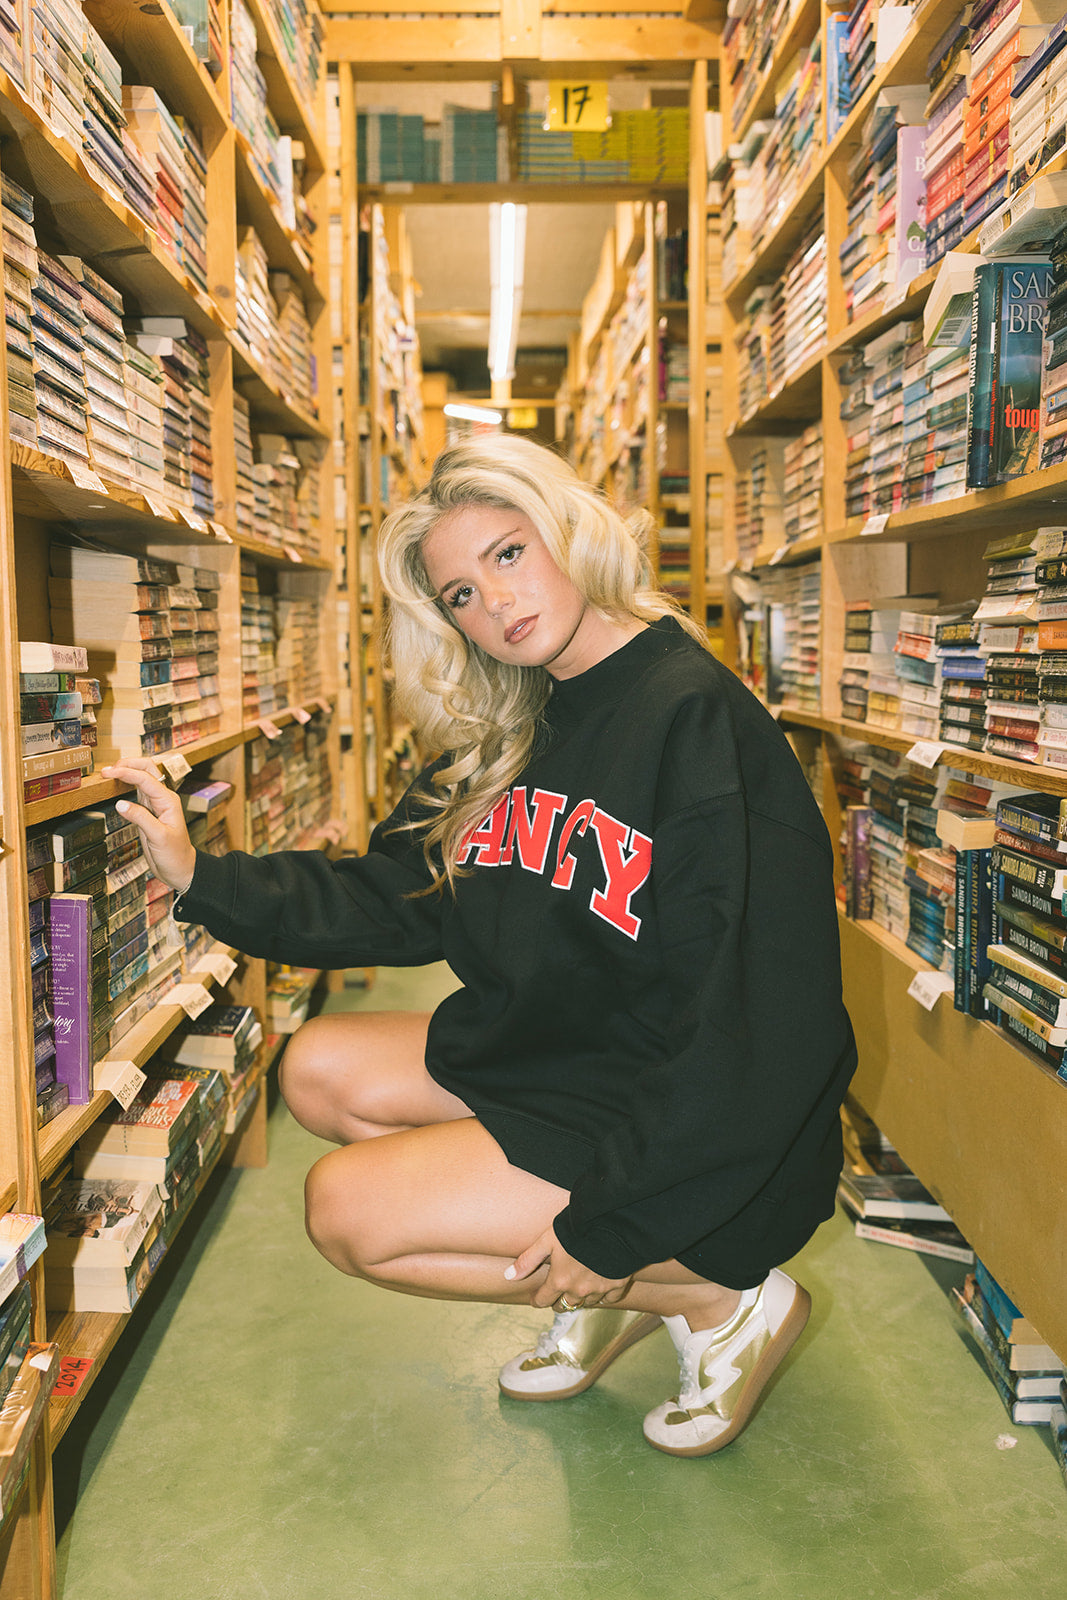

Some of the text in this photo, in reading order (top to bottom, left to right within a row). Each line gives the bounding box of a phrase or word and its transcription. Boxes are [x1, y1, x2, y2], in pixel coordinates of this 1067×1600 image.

[562, 85, 591, 124] 17
[1011, 270, 1056, 299] SAN
[970, 292, 980, 341] SANDRA
[1008, 303, 1044, 333] BR
[968, 343, 978, 389] BROWN
[1004, 404, 1040, 433] toug
[997, 832, 1015, 848] SANDRA
[1014, 838, 1032, 853] BROWN
[455, 785, 654, 942] ANCY
[957, 878, 965, 913] SANDRA
[971, 863, 979, 914] SANDRA
[1011, 885, 1032, 906] SANDRA
[1031, 894, 1052, 915] BROWN
[957, 915, 965, 949] BROWN
[970, 918, 978, 967] BROWN
[1009, 928, 1029, 951] SANDRA
[1028, 939, 1049, 961] BROWN
[1027, 1028, 1048, 1054] BROWN
[54, 1359, 88, 1391] 2014
